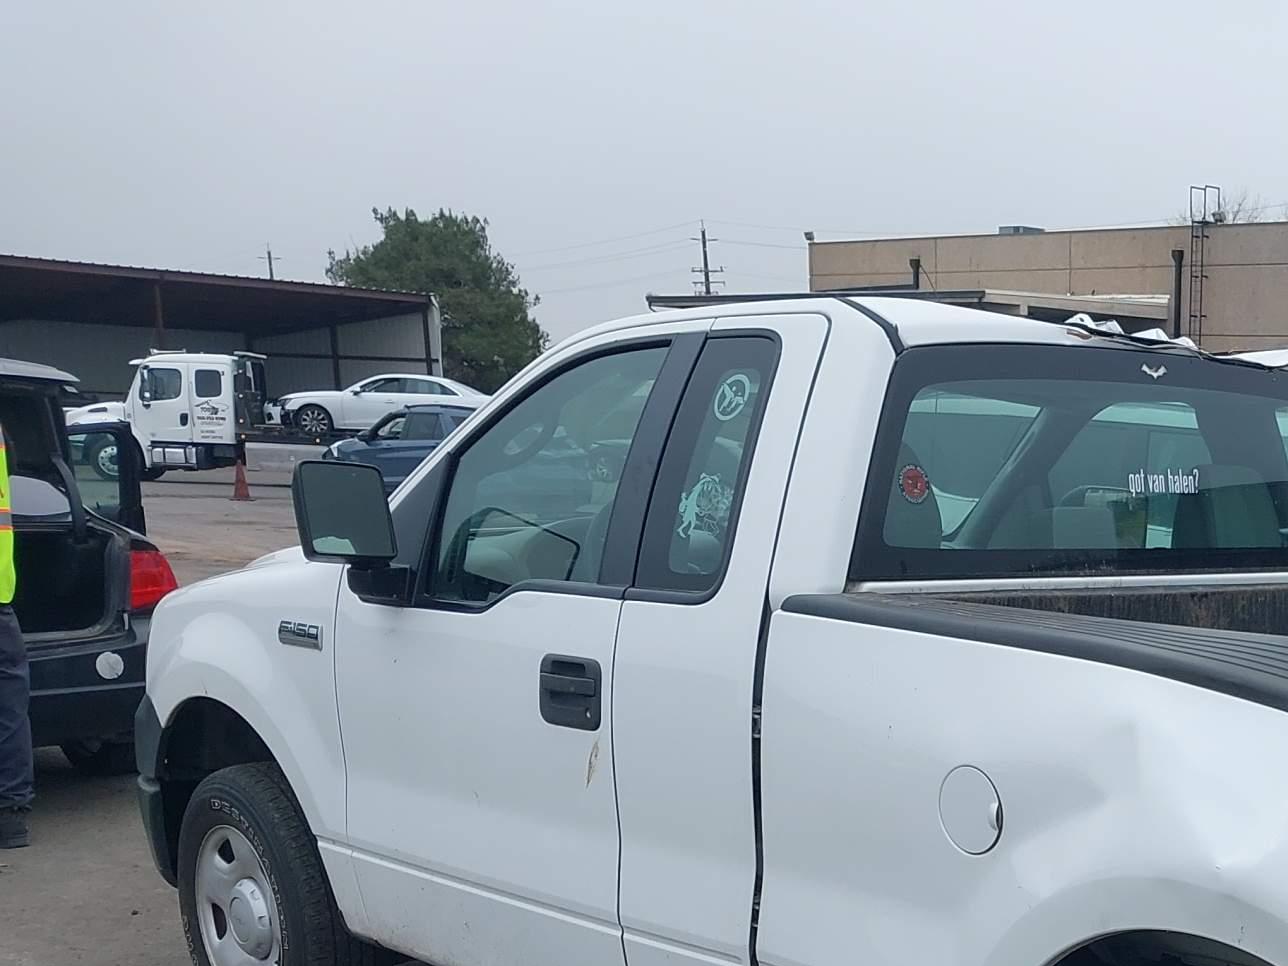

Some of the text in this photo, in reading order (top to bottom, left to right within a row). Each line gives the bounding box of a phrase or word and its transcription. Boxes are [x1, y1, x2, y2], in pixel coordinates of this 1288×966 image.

[1128, 468, 1200, 497] got van halen?
